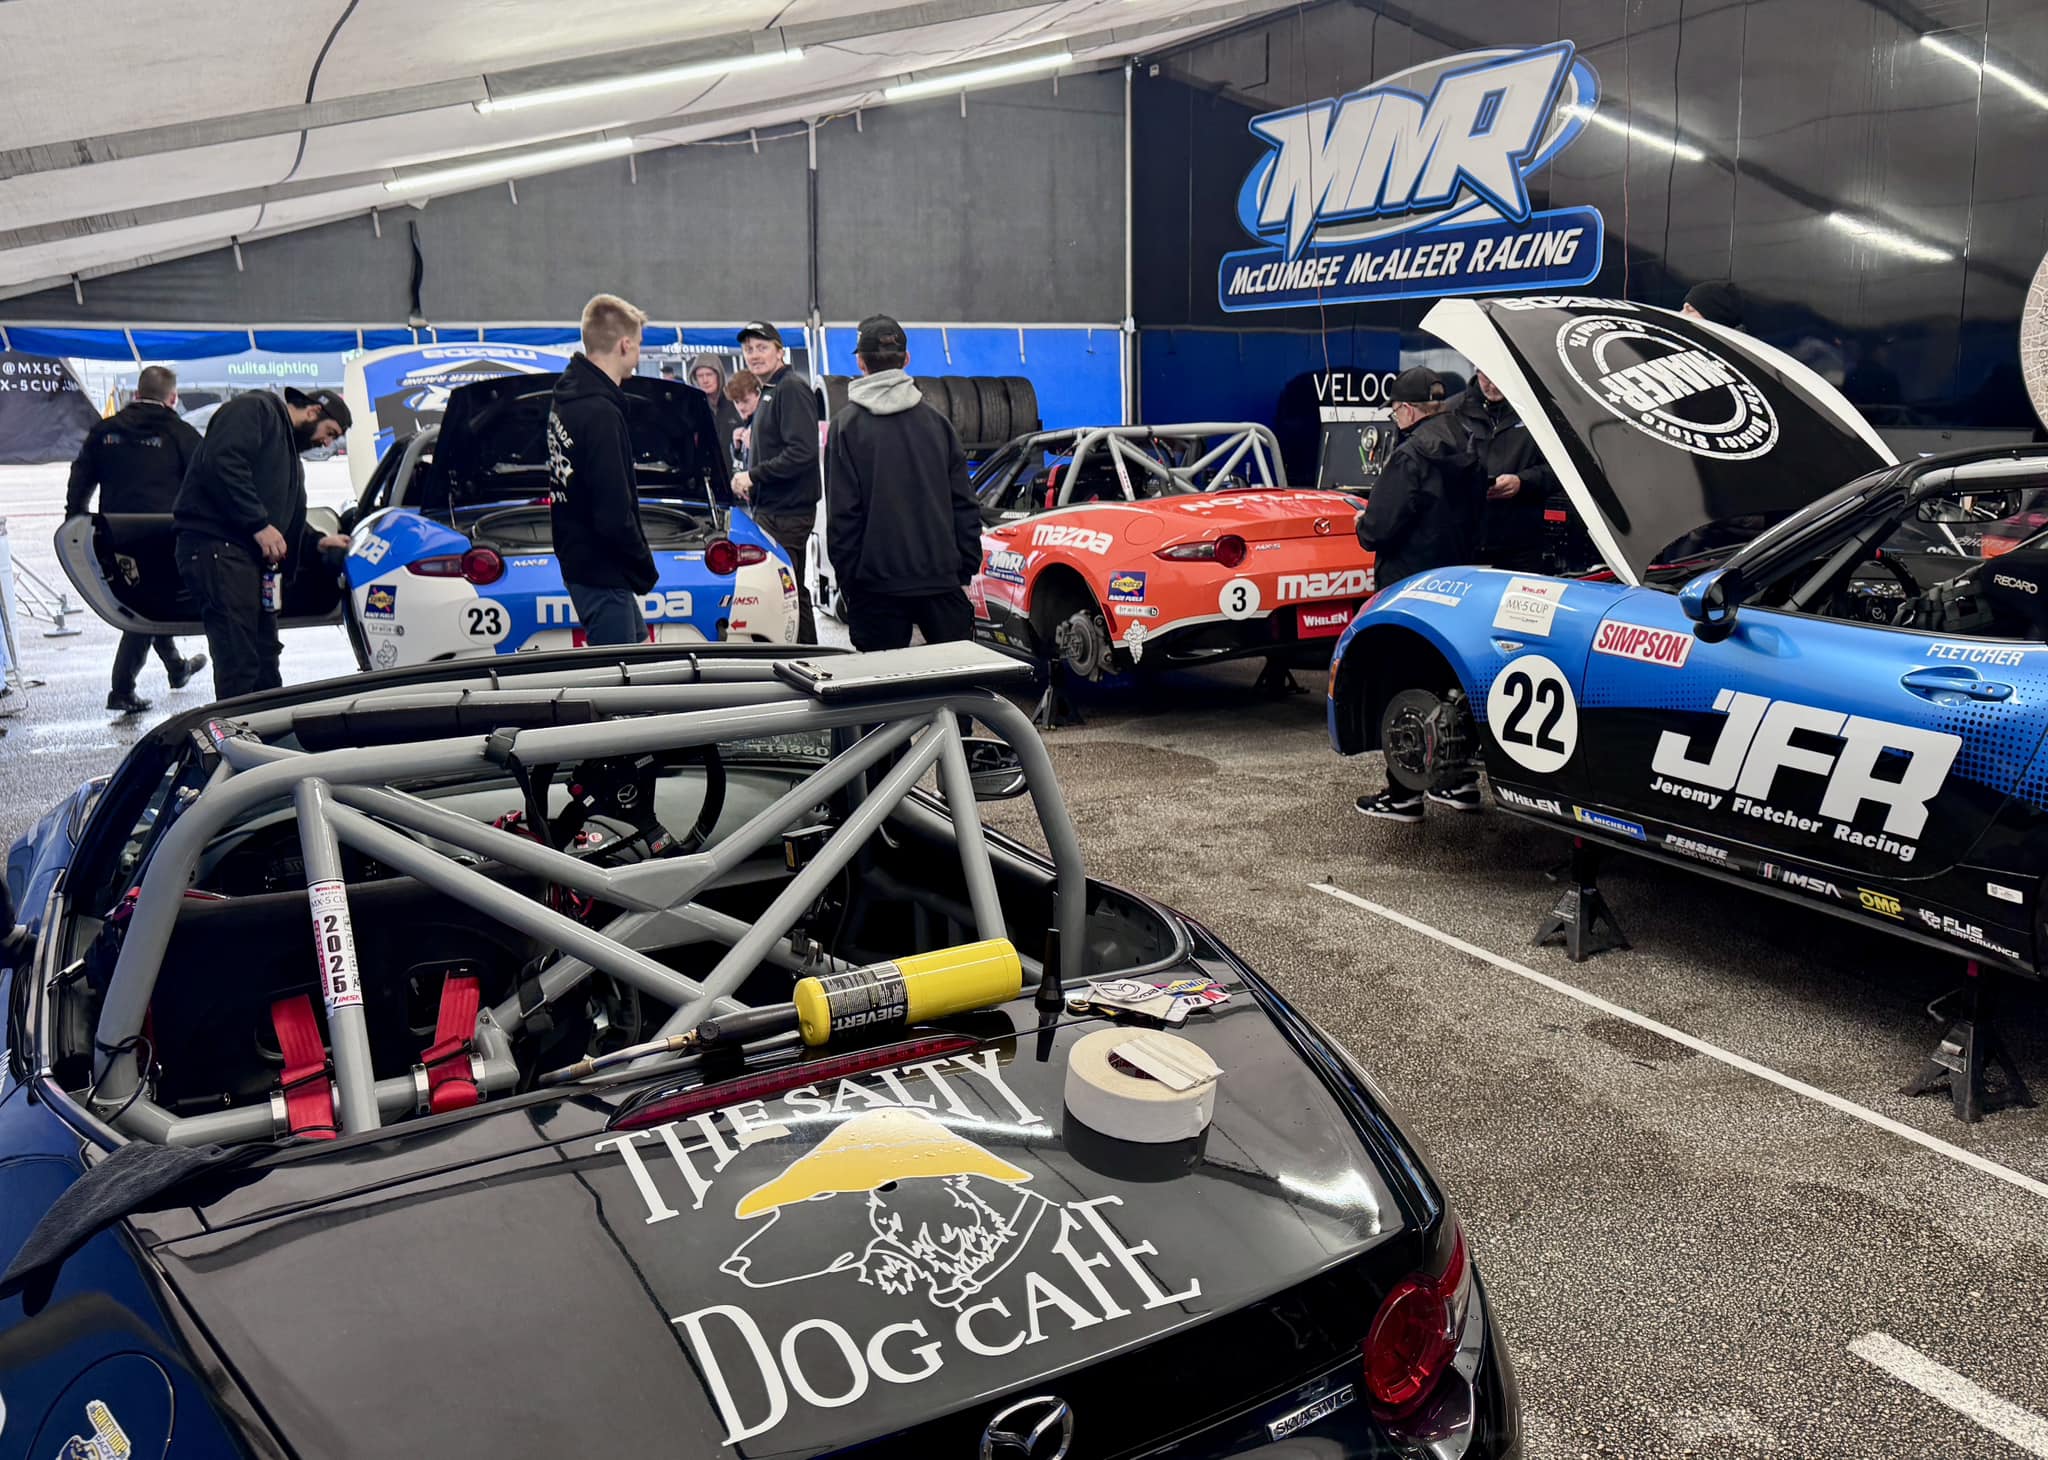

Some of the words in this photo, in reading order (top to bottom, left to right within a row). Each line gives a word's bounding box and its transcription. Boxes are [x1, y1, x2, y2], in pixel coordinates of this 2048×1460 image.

[1250, 46, 1569, 258] MMR
[1229, 255, 1344, 295] McCUMBEE
[1344, 242, 1460, 284] McALEER
[1467, 228, 1583, 274] RACING
[227, 361, 319, 377] nulite.lighting
[1313, 372, 1397, 402] VELOC
[1737, 383, 1764, 415] The
[1641, 412, 1711, 450] Store
[1716, 415, 1770, 450] Holster
[1231, 586, 1247, 613] 3
[1993, 574, 2039, 595] RECARO
[467, 607, 502, 636] 23
[536, 591, 692, 624] mda
[1529, 602, 1549, 614] CUP
[1598, 623, 1688, 663] SIMPSON
[1926, 642, 2025, 667] FLETCHER
[1502, 671, 1565, 755] 22
[1651, 688, 1963, 839] JFR
[1496, 786, 1562, 816] WHELEN
[1593, 816, 1638, 834] MICHELIN
[1650, 777, 1723, 811] Jeremy
[1731, 796, 1823, 834] Fletcher
[1833, 823, 1917, 863] Racing
[1664, 834, 1729, 860] PENSKE
[1782, 870, 1842, 900] IMSA
[1858, 891, 1902, 914] OMP
[1943, 915, 1984, 939] FLIS
[1943, 926, 2020, 959] PERFORMANCE
[323, 914, 348, 994] 2025
[595, 1099, 771, 1225] THE
[783, 1049, 1046, 1126] SALTY
[672, 1304, 944, 1447] DOG
